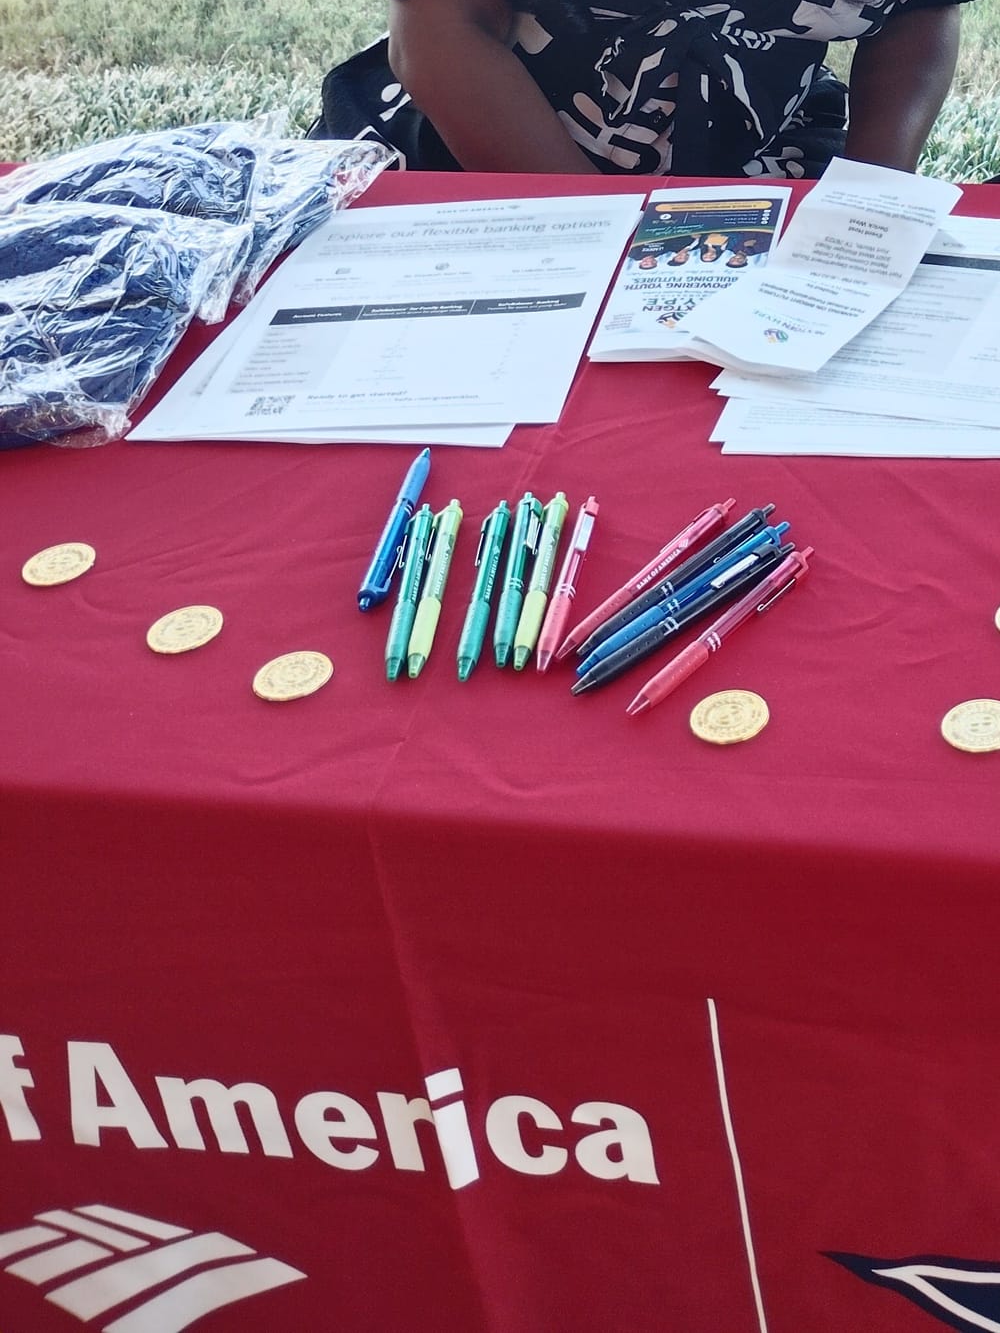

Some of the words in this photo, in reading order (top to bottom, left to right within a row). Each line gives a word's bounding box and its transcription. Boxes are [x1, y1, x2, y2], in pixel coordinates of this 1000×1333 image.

[849, 218, 867, 228] West
[868, 223, 889, 233] Derick
[328, 232, 386, 242] Explore
[391, 230, 415, 238] our
[422, 225, 479, 237] flexible
[483, 223, 546, 235] banking
[552, 219, 612, 231] options
[848, 225, 864, 235] Host
[866, 229, 883, 239] Event
[634, 276, 683, 284] FUTURES.
[686, 276, 739, 284] BUILDING
[624, 282, 662, 291] YOUTH.
[664, 282, 732, 290] POWERING
[643, 297, 703, 306] .Y.P.E.
[636, 574, 652, 590] BANK
[650, 567, 659, 578] OF
[657, 548, 681, 571] AMERICA
[67, 1041, 661, 1190] America
